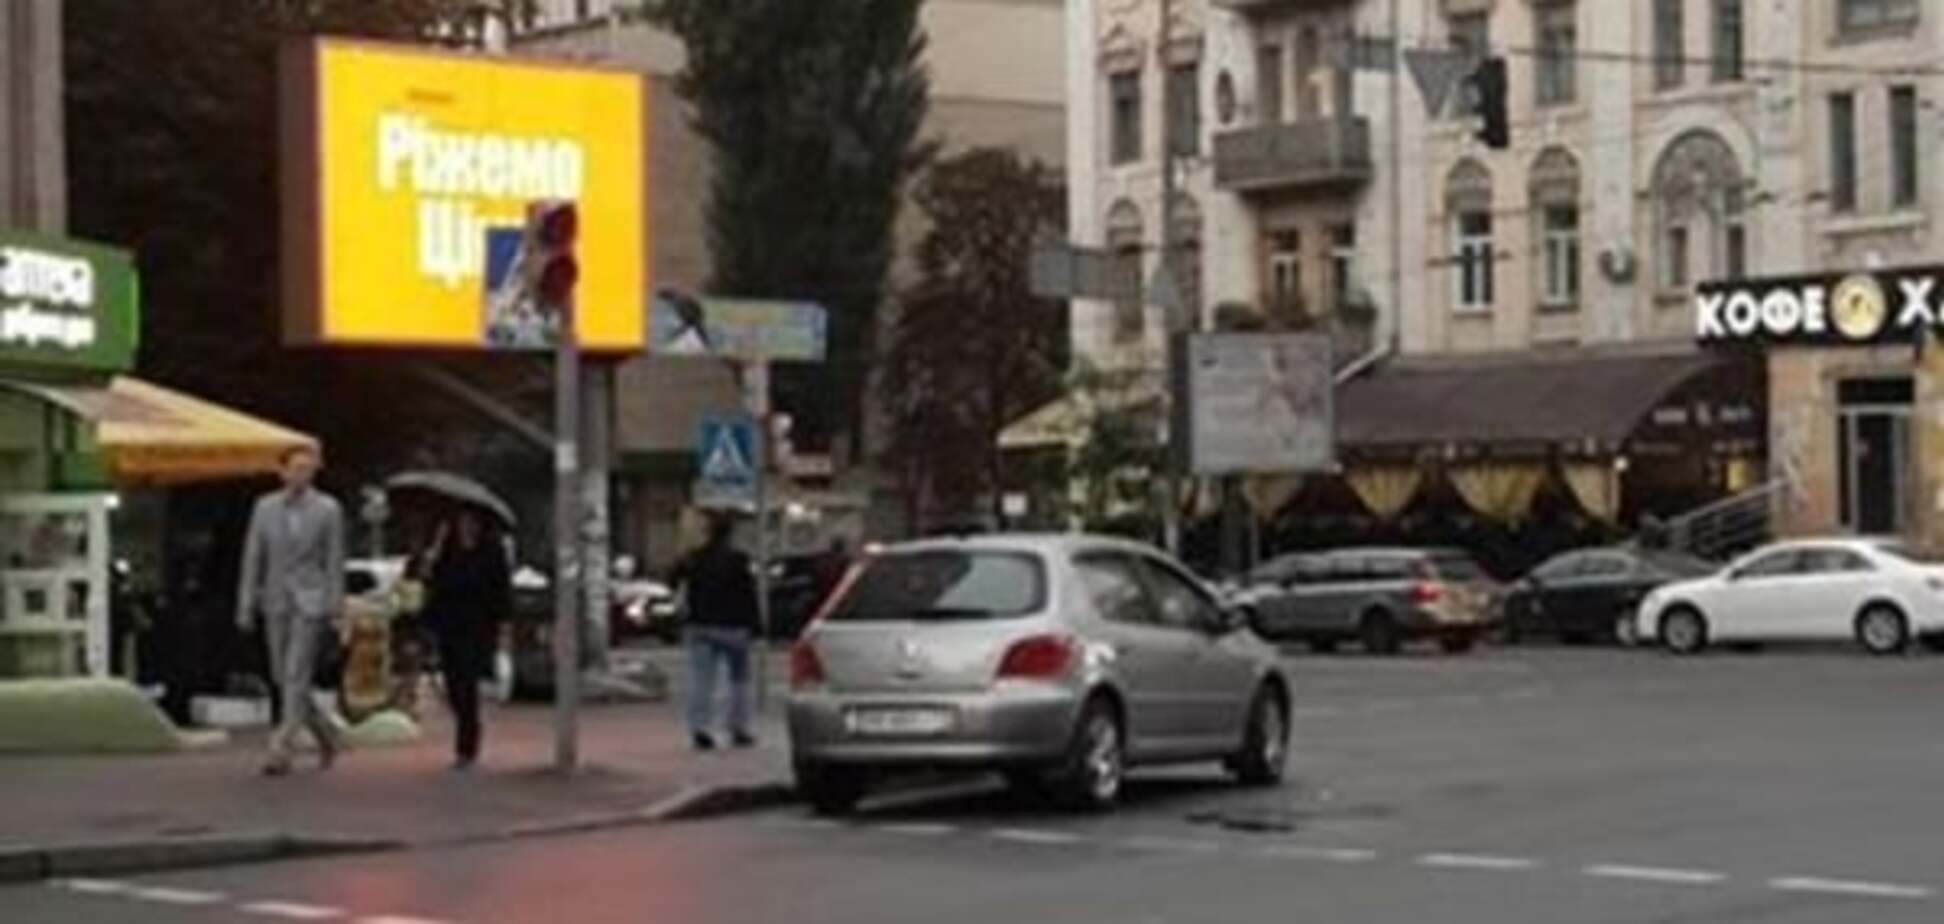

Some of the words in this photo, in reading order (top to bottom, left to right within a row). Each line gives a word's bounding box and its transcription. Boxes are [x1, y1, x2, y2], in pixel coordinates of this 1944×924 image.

[377, 111, 583, 200] Ріжемо
[417, 199, 525, 288] Ці
[1697, 285, 1825, 336] КОФЕ
[1897, 271, 1944, 328] Х
